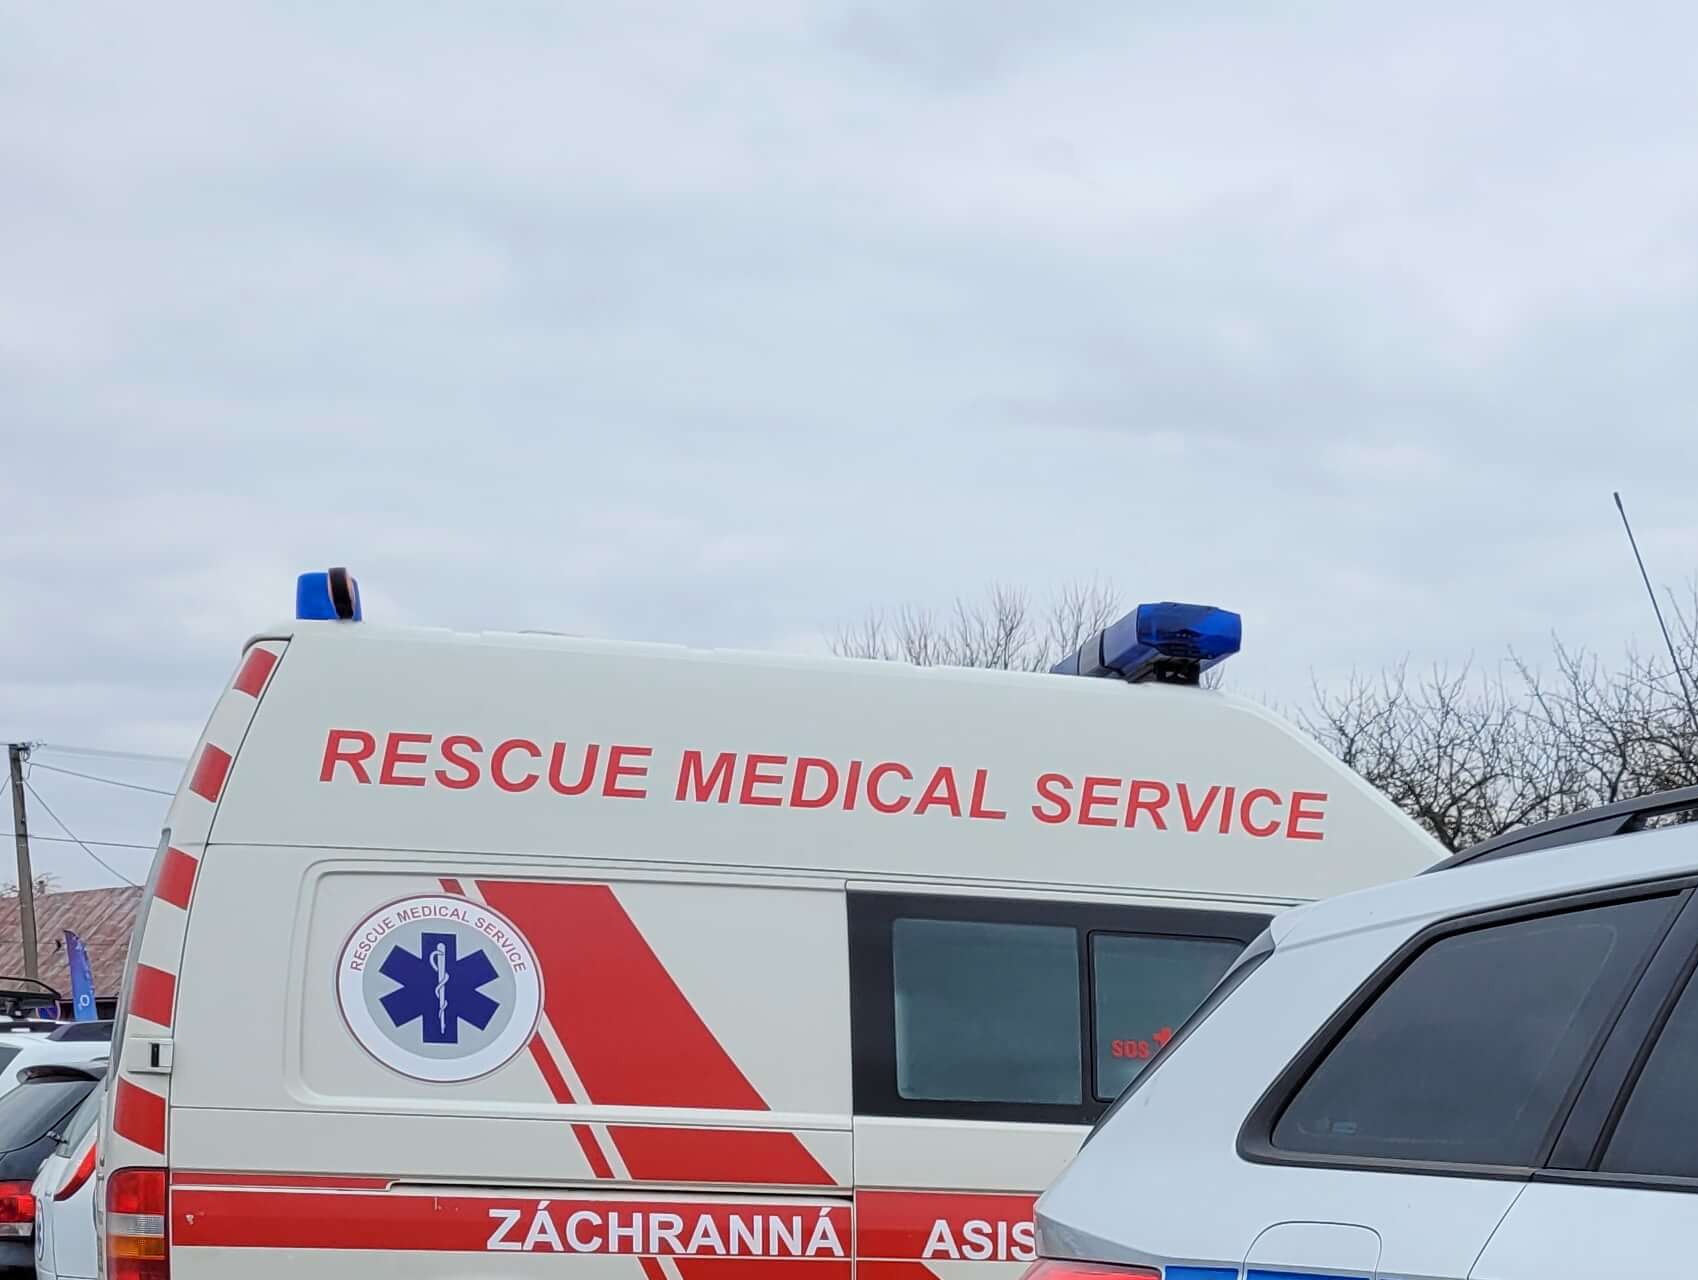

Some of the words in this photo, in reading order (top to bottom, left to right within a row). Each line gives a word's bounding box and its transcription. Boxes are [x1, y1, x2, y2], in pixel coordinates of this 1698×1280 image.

[318, 728, 654, 801] RESCUE
[675, 749, 1008, 820] MEDICAL
[1031, 772, 1329, 841] SERVICE
[350, 916, 396, 972] RESCUE
[397, 904, 470, 924] MEDICAL
[474, 916, 527, 974] SERVICE
[1111, 1039, 1149, 1058] SOS
[486, 1200, 845, 1256] ZÁCHRANNÁ
[921, 1219, 1038, 1261] ASIS
